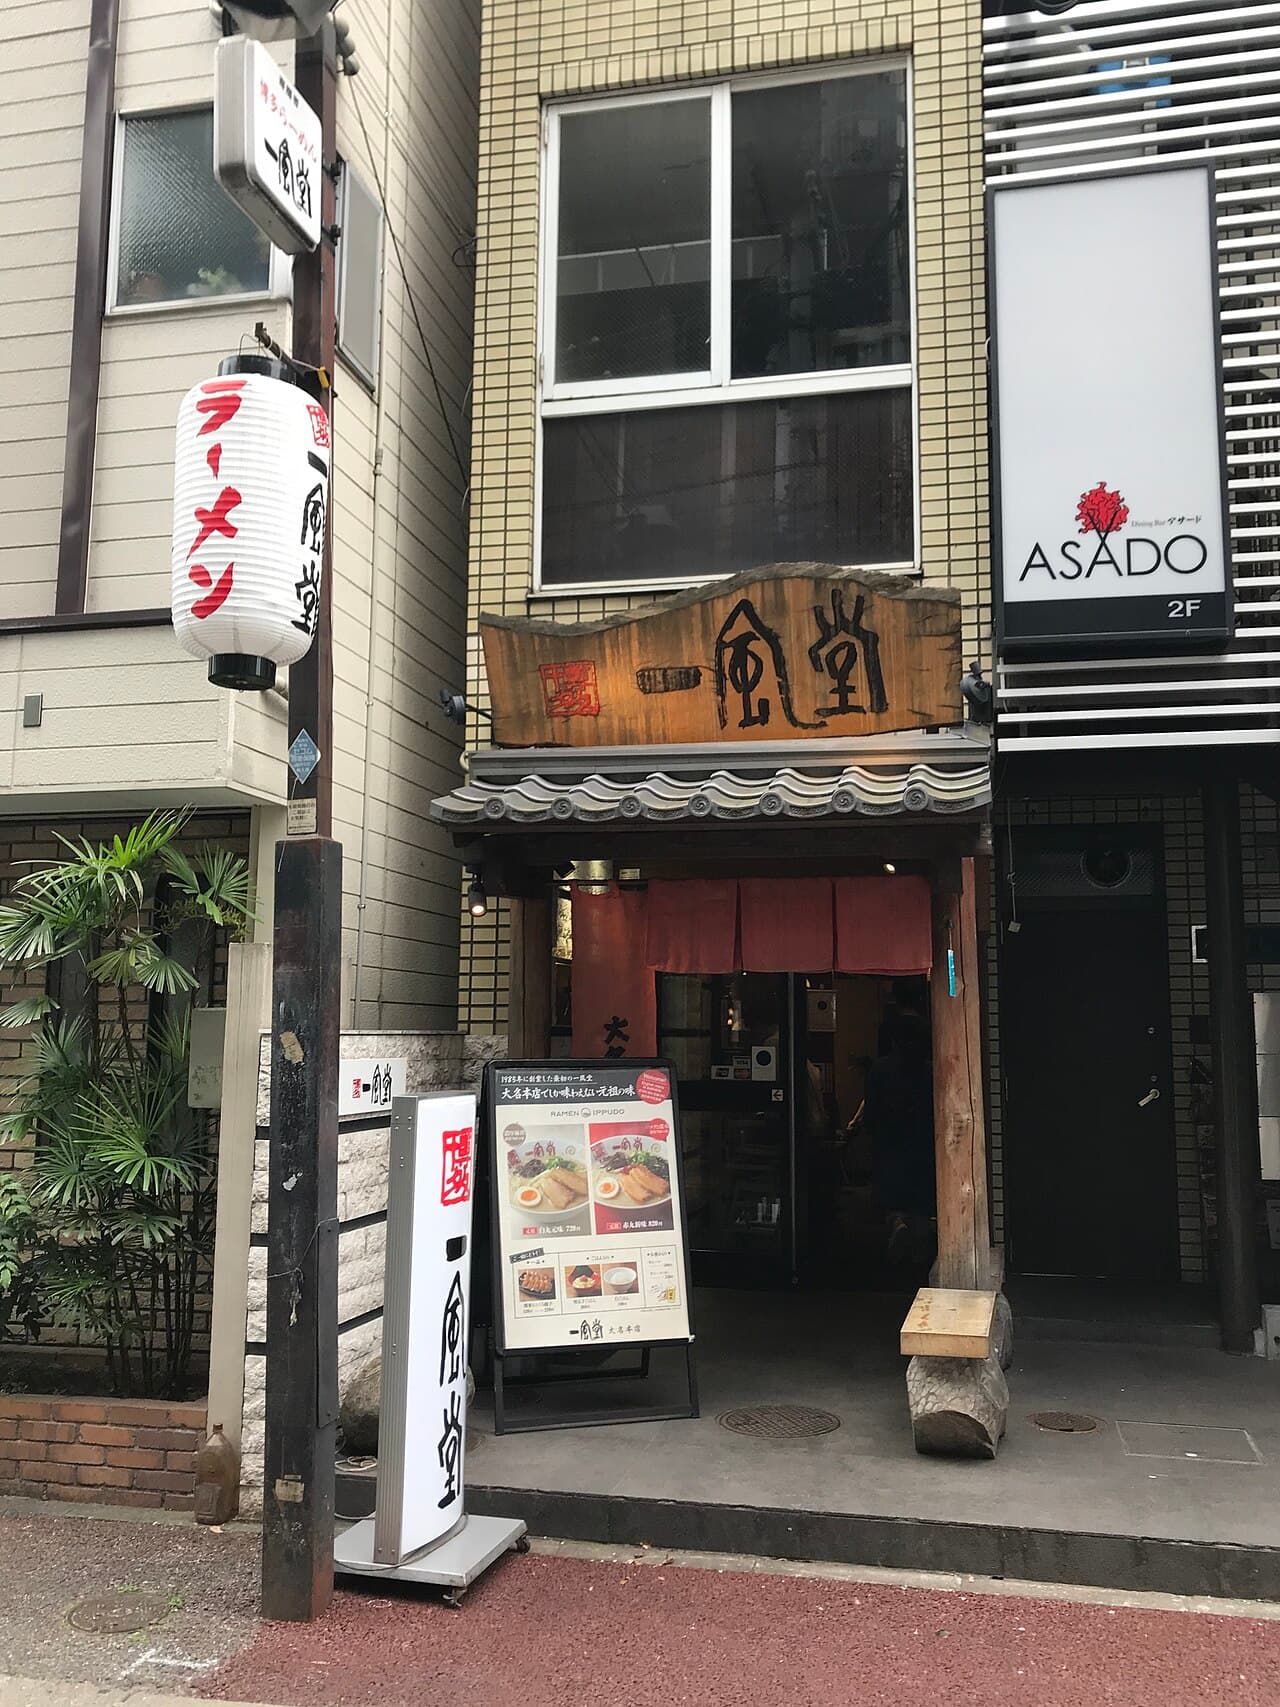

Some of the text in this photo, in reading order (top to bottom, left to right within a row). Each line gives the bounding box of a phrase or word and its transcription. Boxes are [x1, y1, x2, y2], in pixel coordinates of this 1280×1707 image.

[264, 137, 313, 219] 一風堂
[185, 380, 248, 620] ラーメン
[291, 450, 329, 638] 一風堂
[1019, 534, 1208, 582] ASADO
[1168, 600, 1203, 618] 2F
[635, 588, 891, 731] 一風堂
[362, 1063, 393, 1106] 一風堂
[501, 1084, 636, 1100] 大名本店でしか味わえない元祖の味
[592, 1108, 625, 1116] IPPUDO
[569, 1318, 603, 1341] 一風堂
[438, 1235, 467, 1509] 一風堂
